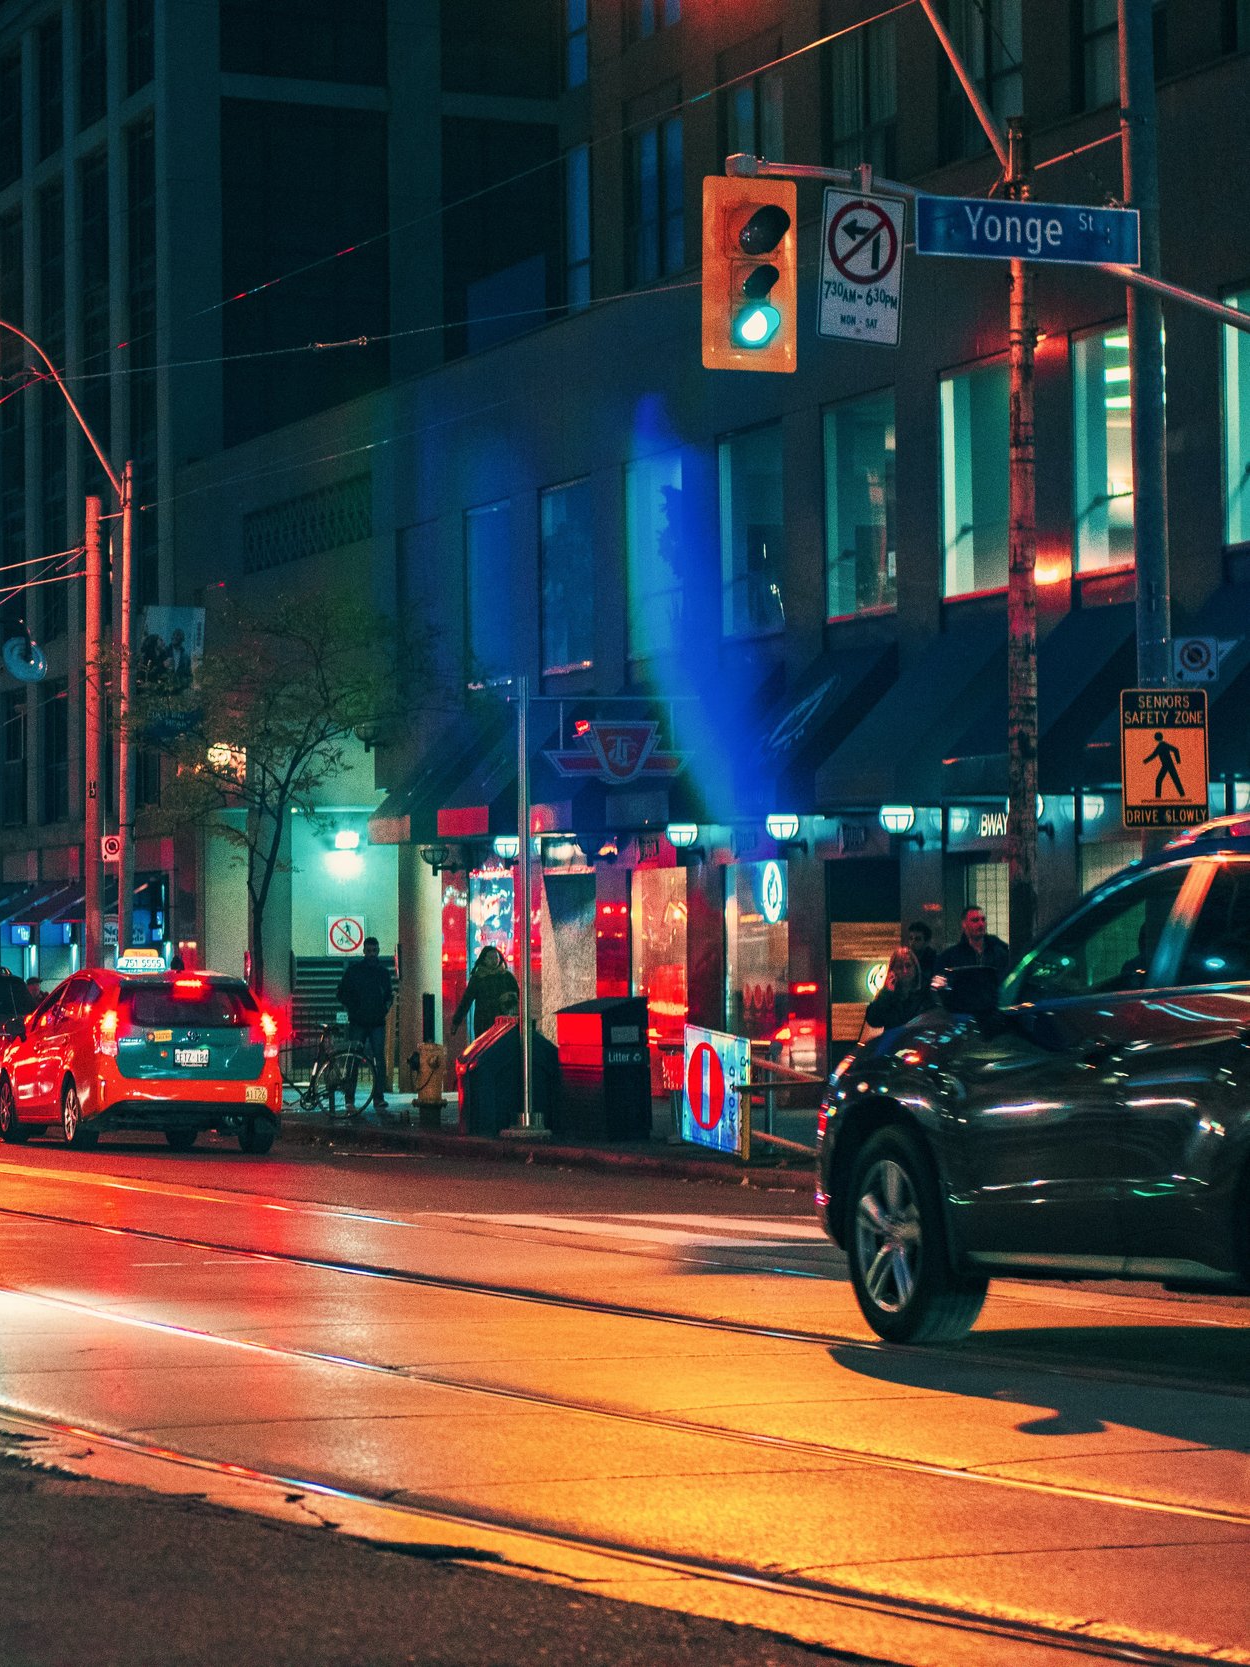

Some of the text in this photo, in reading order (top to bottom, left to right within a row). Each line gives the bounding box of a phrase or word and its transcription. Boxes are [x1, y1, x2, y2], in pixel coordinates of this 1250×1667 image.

[964, 206, 1094, 254] Yonge St
[840, 314, 856, 326] MON
[866, 318, 877, 329] SAT
[1138, 695, 1190, 708] SENIORS
[1124, 710, 1203, 724] SAFETY ZONE
[1126, 808, 1207, 823] DRIVE SLOWLY
[608, 1052, 630, 1063] Litter
